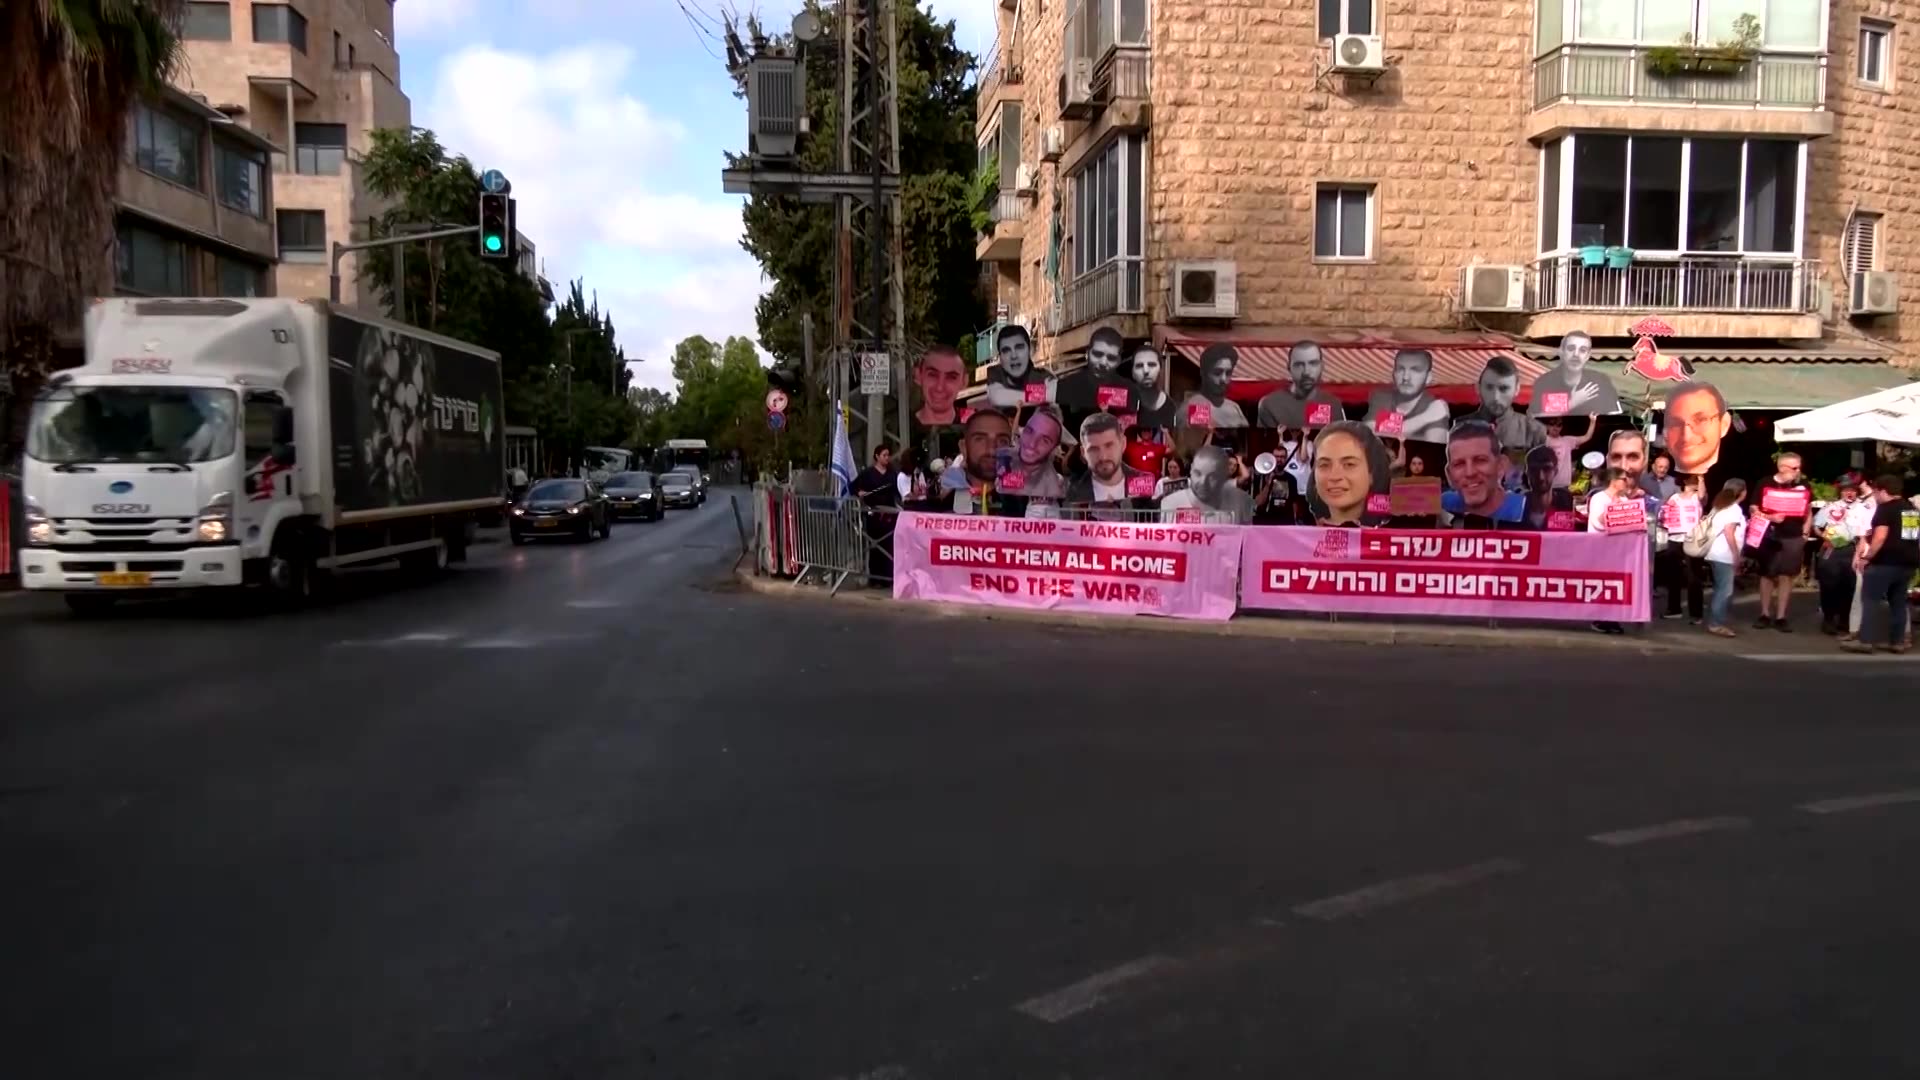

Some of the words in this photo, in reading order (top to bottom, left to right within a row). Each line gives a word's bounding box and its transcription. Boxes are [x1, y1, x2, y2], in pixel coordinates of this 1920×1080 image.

[112, 358, 172, 374] ISUZU
[92, 503, 150, 514] ISUZU
[915, 516, 1000, 532] PRESIDENT
[1004, 520, 1057, 534] TRUMP
[1080, 524, 1130, 539] MAKE
[1135, 527, 1216, 546] HISTORY
[1390, 536, 1443, 557] עזה
[1450, 537, 1530, 560] כיבוש
[939, 544, 997, 563] BRING
[1002, 548, 1060, 567] THEM
[1065, 551, 1105, 570] ALL
[1111, 554, 1177, 576] HOME
[970, 573, 1020, 594] END
[1027, 576, 1075, 598] THE
[1083, 580, 1141, 602] WAR
[1269, 567, 1387, 592] והחיילים
[1395, 572, 1519, 597] החטופים
[1525, 576, 1624, 603] הקרבת
